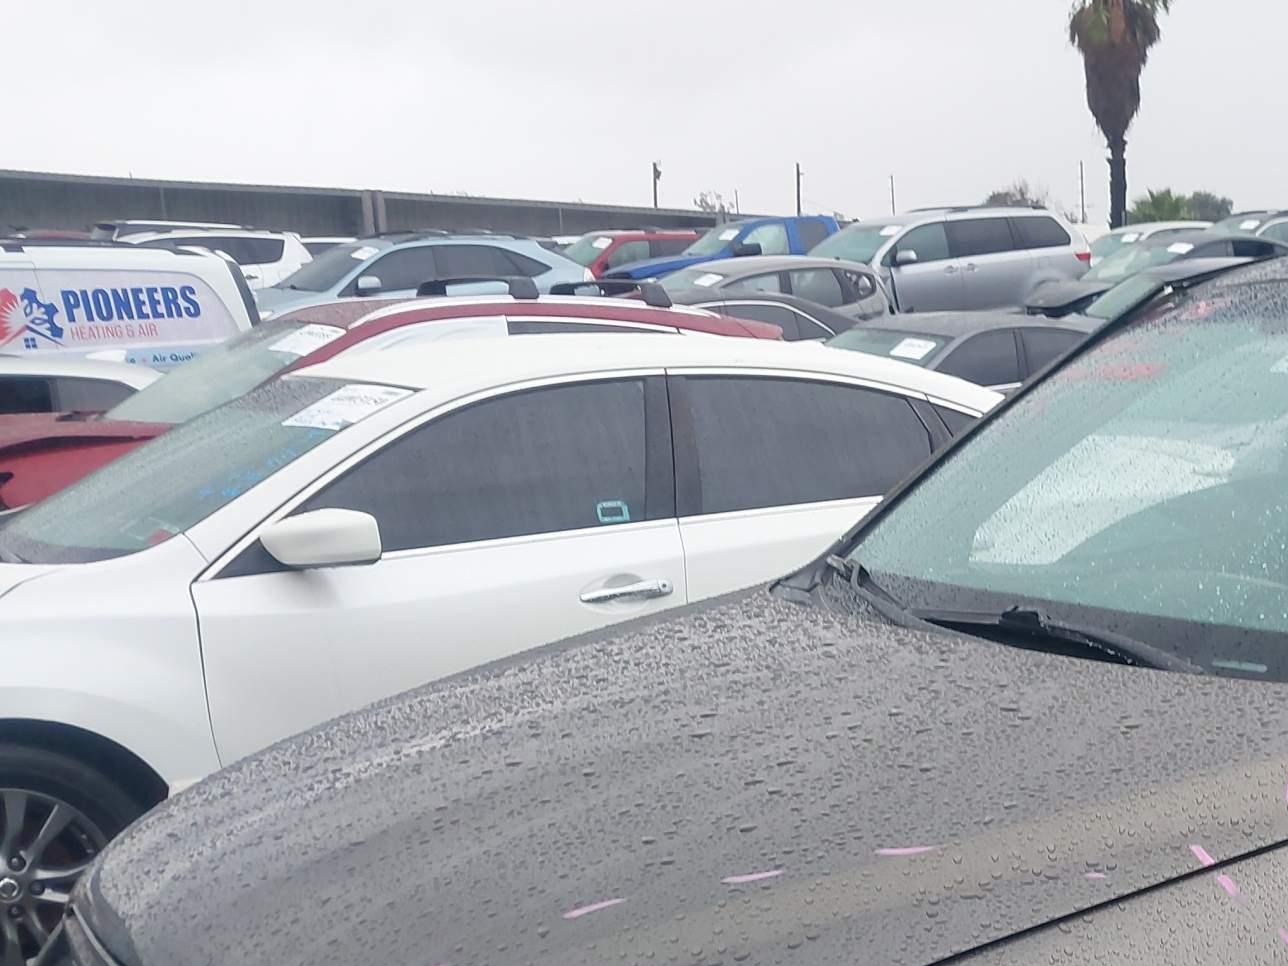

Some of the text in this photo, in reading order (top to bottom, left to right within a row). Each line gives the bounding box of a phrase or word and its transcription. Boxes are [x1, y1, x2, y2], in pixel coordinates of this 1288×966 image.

[61, 286, 201, 323] PIONEERS
[70, 325, 122, 340] HEATING
[139, 323, 159, 337] AIR
